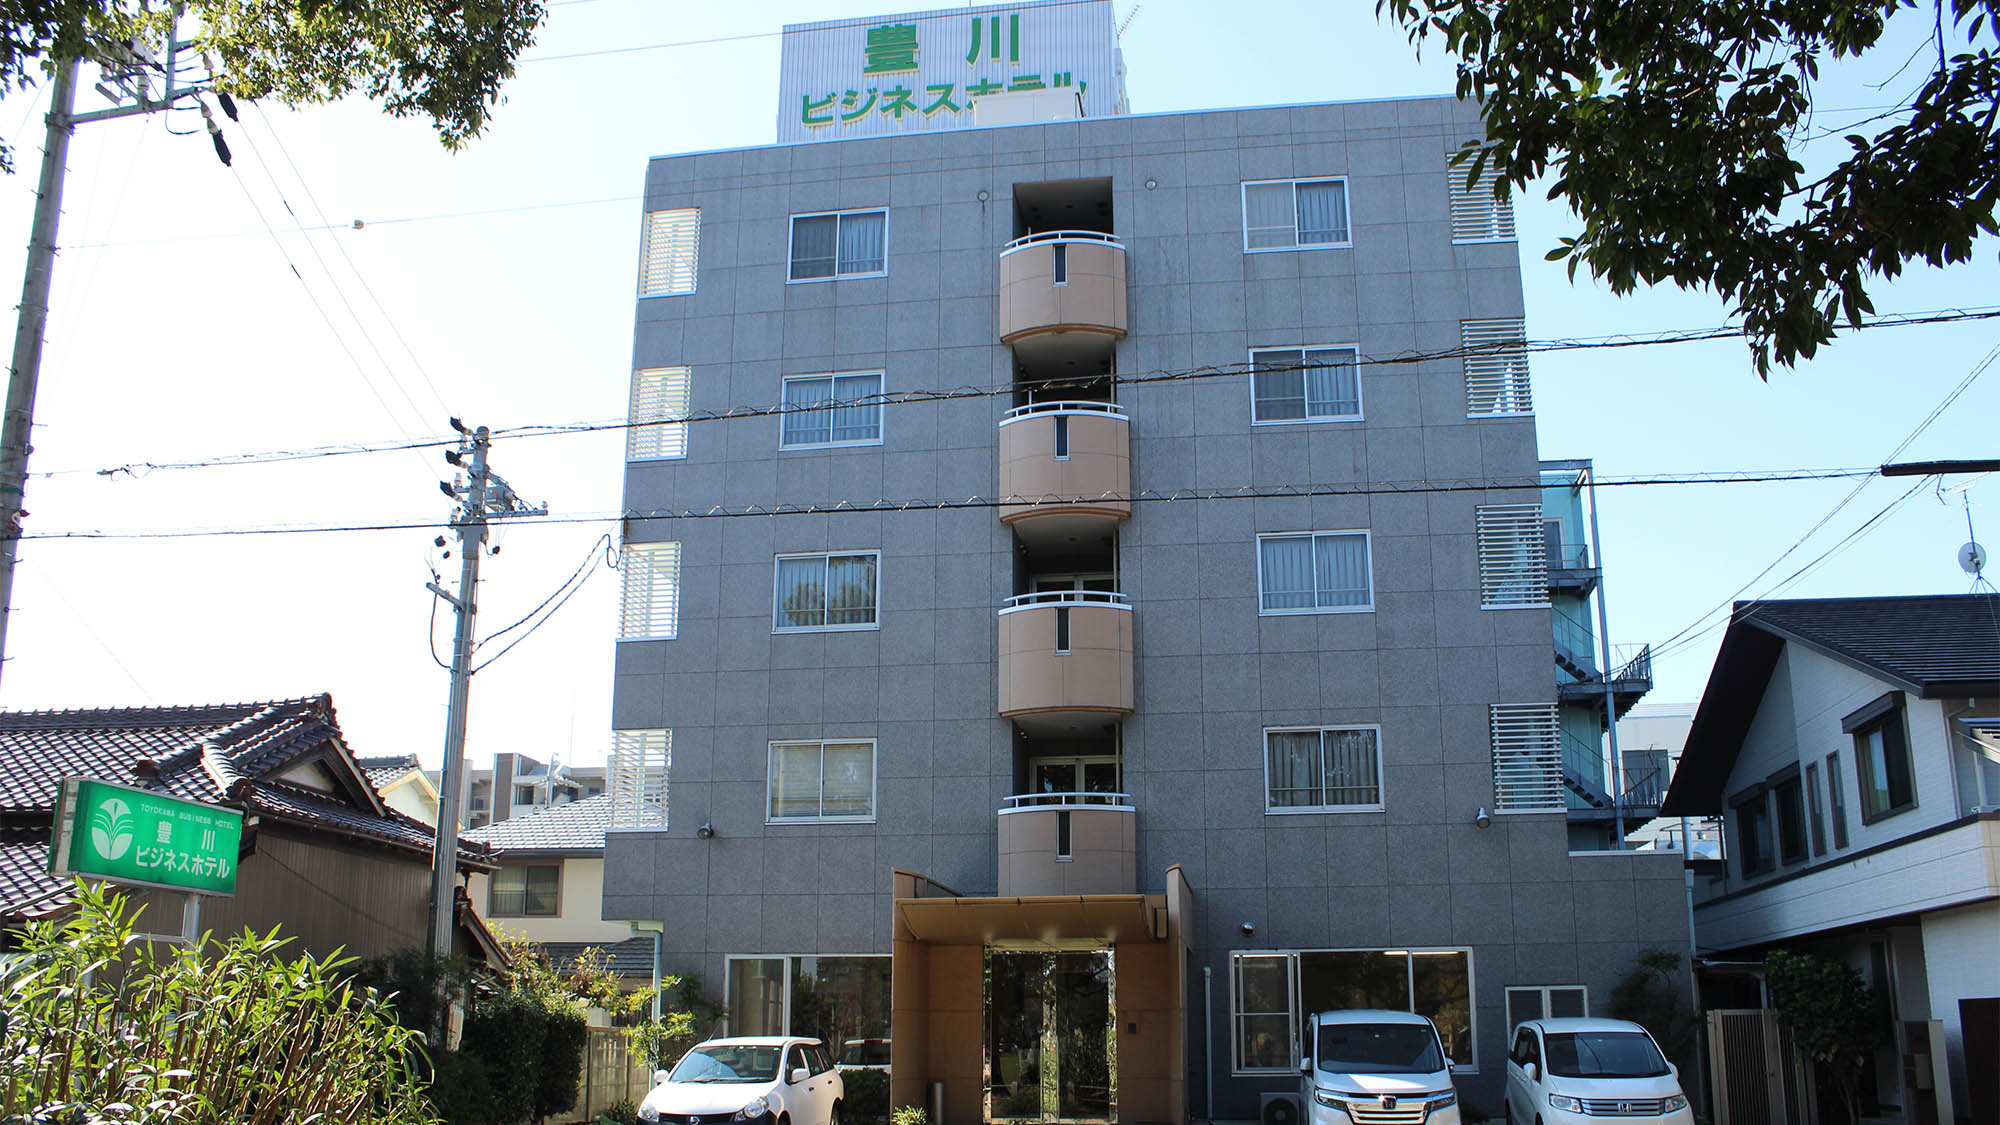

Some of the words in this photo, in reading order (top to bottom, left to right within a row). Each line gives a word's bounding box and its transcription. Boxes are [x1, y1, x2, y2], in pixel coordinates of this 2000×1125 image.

[178, 812, 211, 825] BUSINESS
[214, 820, 235, 830] HOTEL
[136, 846, 230, 879] ビジネスホテル
